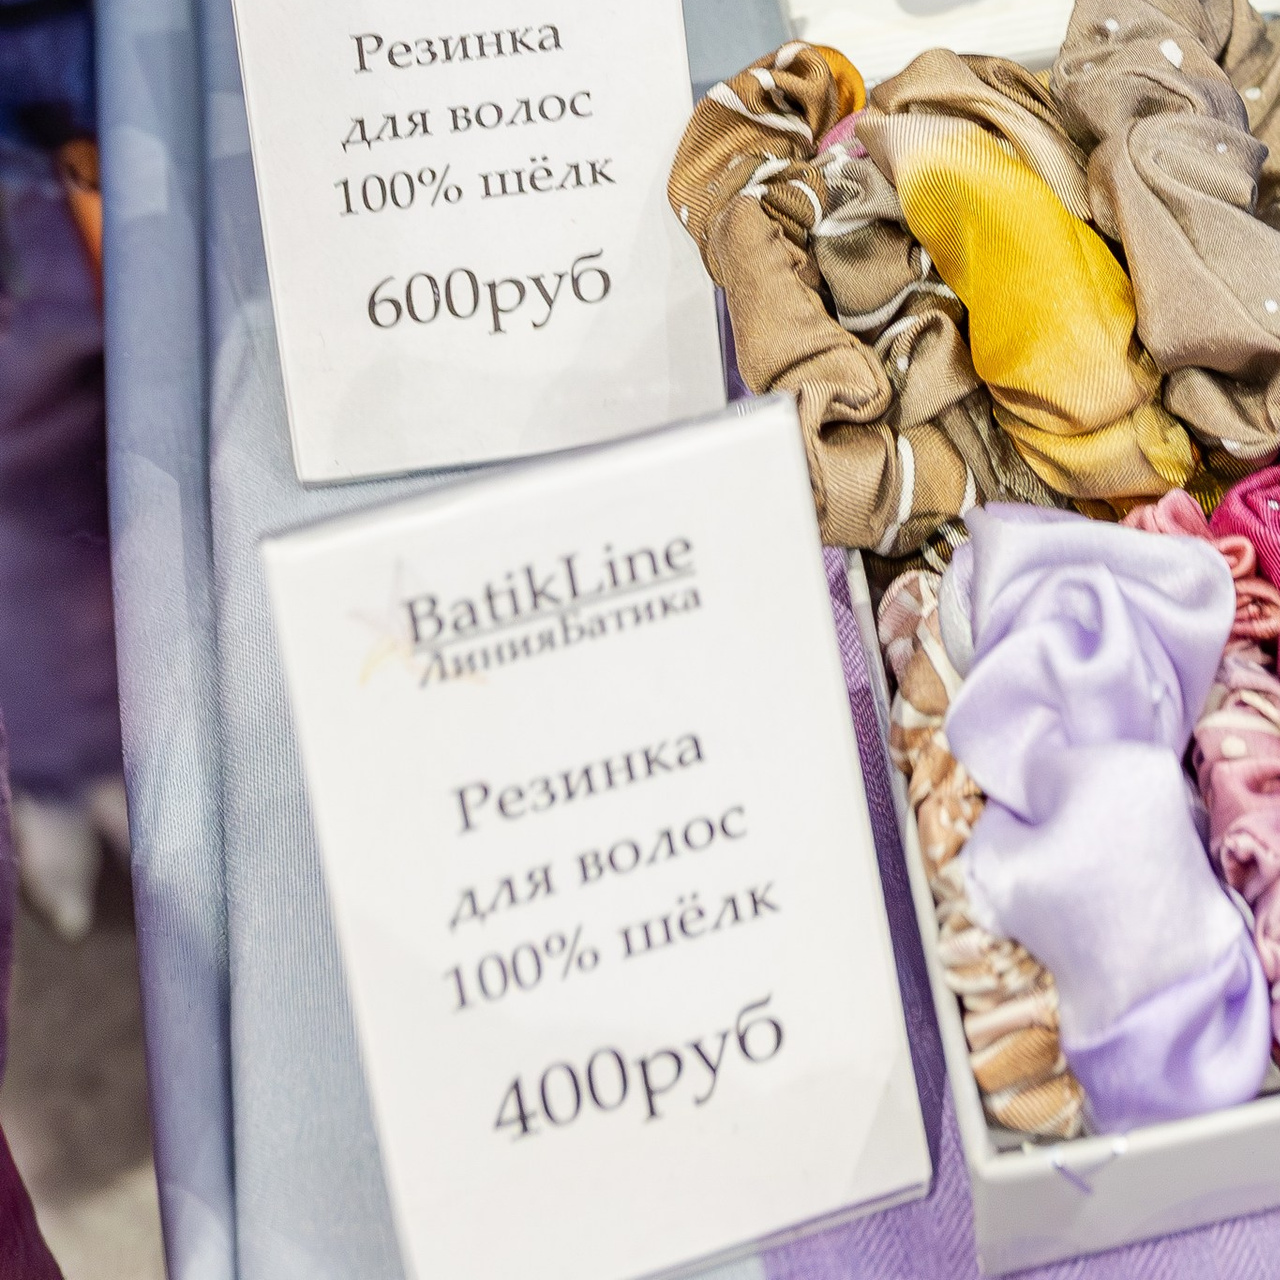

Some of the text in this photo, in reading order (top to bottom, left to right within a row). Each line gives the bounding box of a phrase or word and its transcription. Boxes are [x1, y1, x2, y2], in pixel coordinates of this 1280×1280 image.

[350, 23, 564, 74] Резинка
[341, 90, 593, 153] для волос
[334, 155, 617, 217] 100% шёлк
[367, 248, 611, 335] 600руб
[402, 536, 693, 644] BatikLine
[418, 587, 703, 690] ЛинияБатика
[452, 732, 705, 835] Резинка
[449, 805, 748, 931] для волос
[442, 881, 781, 1013] 100% шёлк
[493, 993, 784, 1141] 400руб
